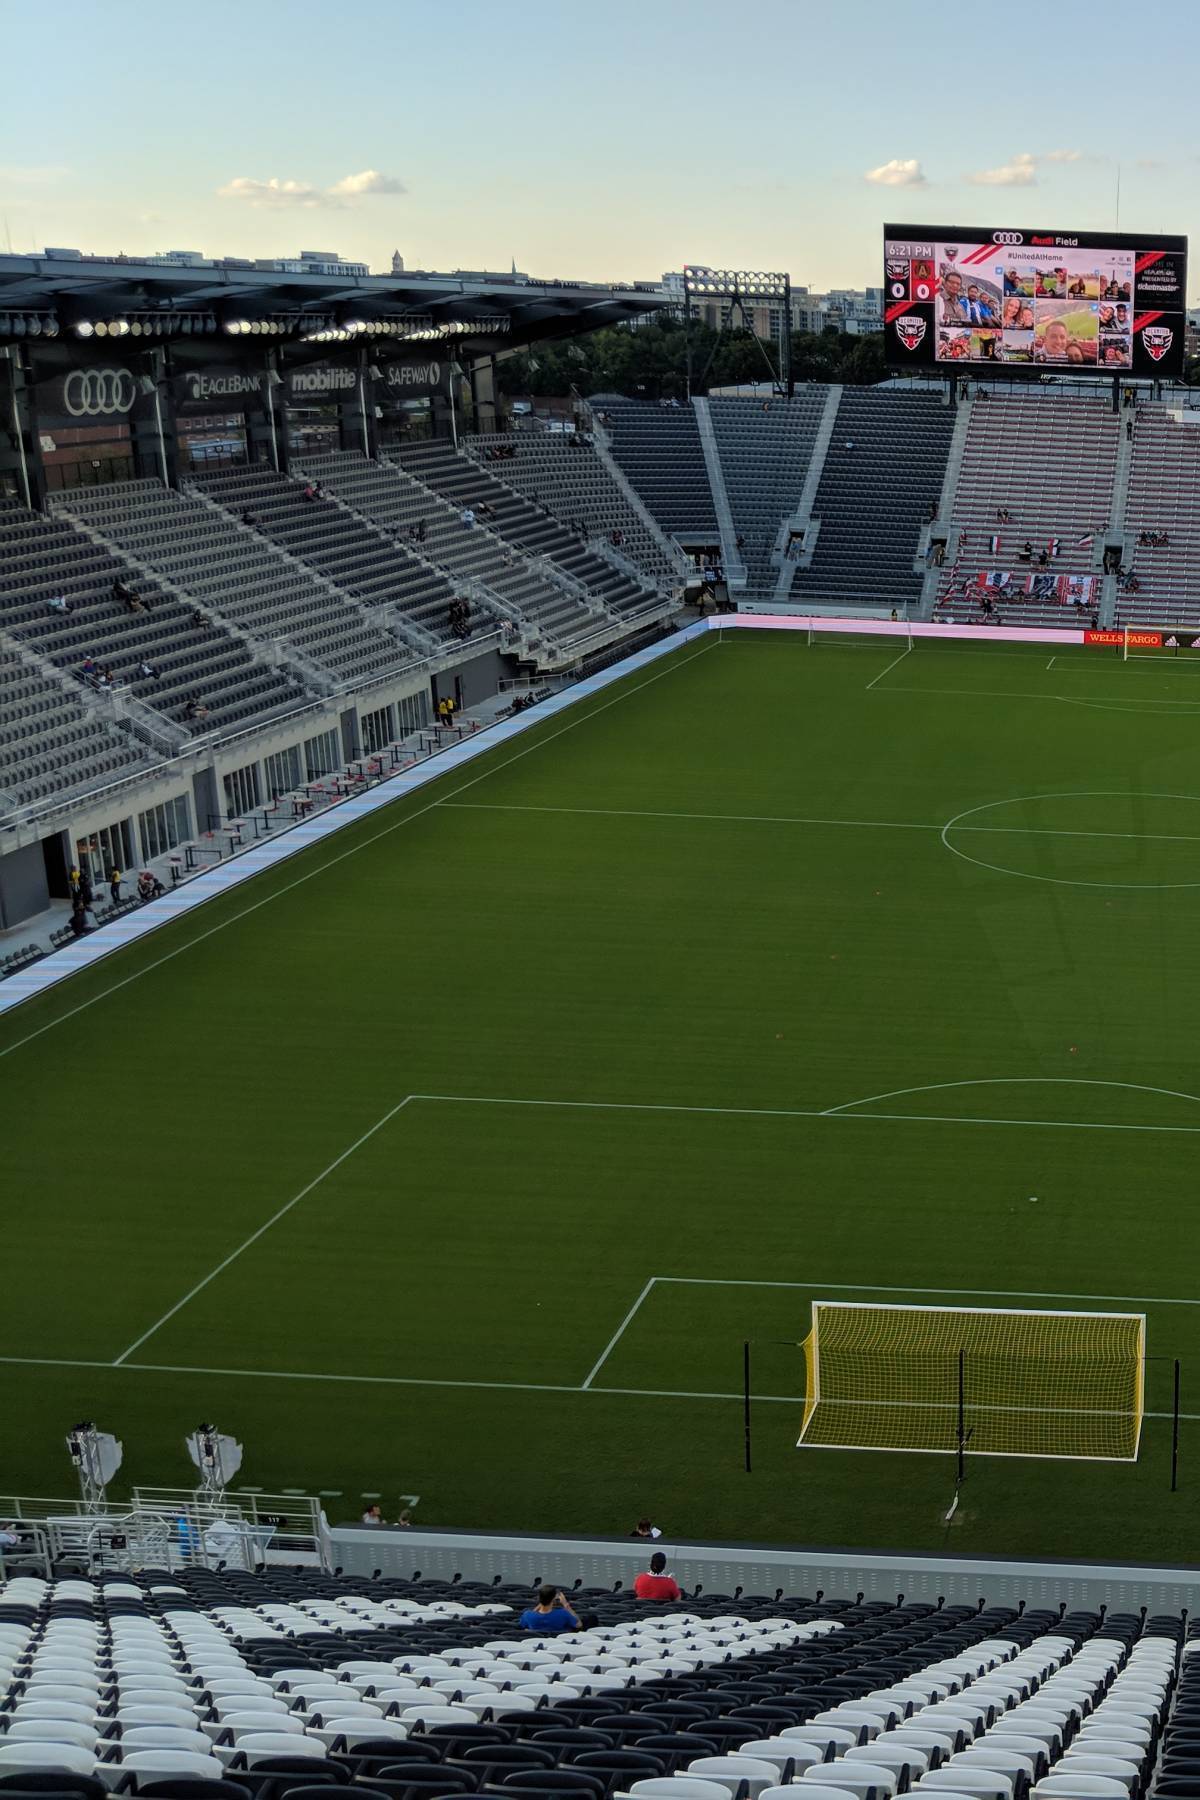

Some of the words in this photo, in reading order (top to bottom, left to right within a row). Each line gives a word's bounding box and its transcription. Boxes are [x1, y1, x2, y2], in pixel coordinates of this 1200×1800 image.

[1031, 236, 1054, 245] Audi
[1055, 237, 1078, 246] Field
[889, 245, 911, 256] 6:21
[915, 246, 932, 257] PM
[1007, 252, 1063, 262] #UnitedAtHome
[892, 283, 905, 299] 0
[917, 284, 930, 299] 0
[1137, 283, 1175, 292] ticketmaster
[292, 368, 356, 392] mobilitie
[388, 367, 429, 386] SAFEWAY
[1089, 633, 1124, 643] WELLS
[1125, 635, 1158, 645] FARGO
